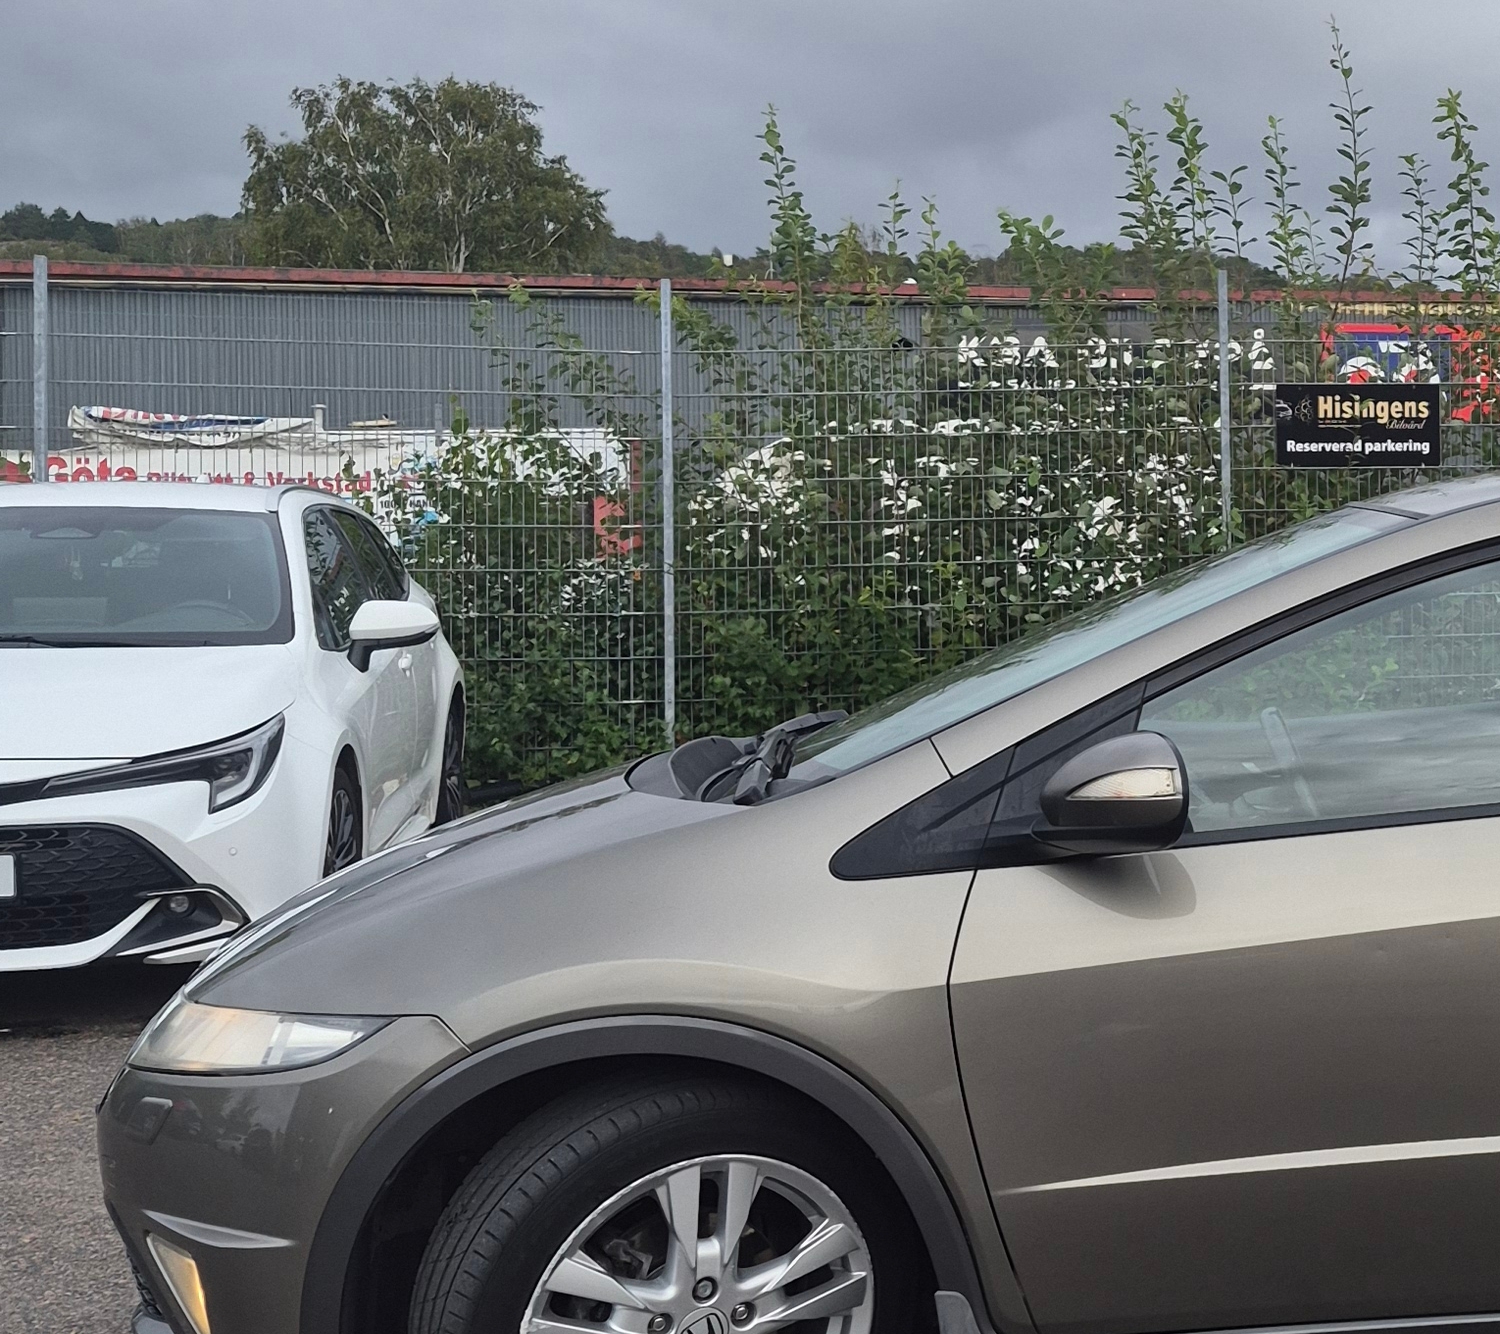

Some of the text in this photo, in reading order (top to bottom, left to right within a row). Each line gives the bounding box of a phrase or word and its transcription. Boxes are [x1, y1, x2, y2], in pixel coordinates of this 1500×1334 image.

[1317, 394, 1430, 424] Hisingens
[1286, 439, 1431, 455] Reserverad parkering
